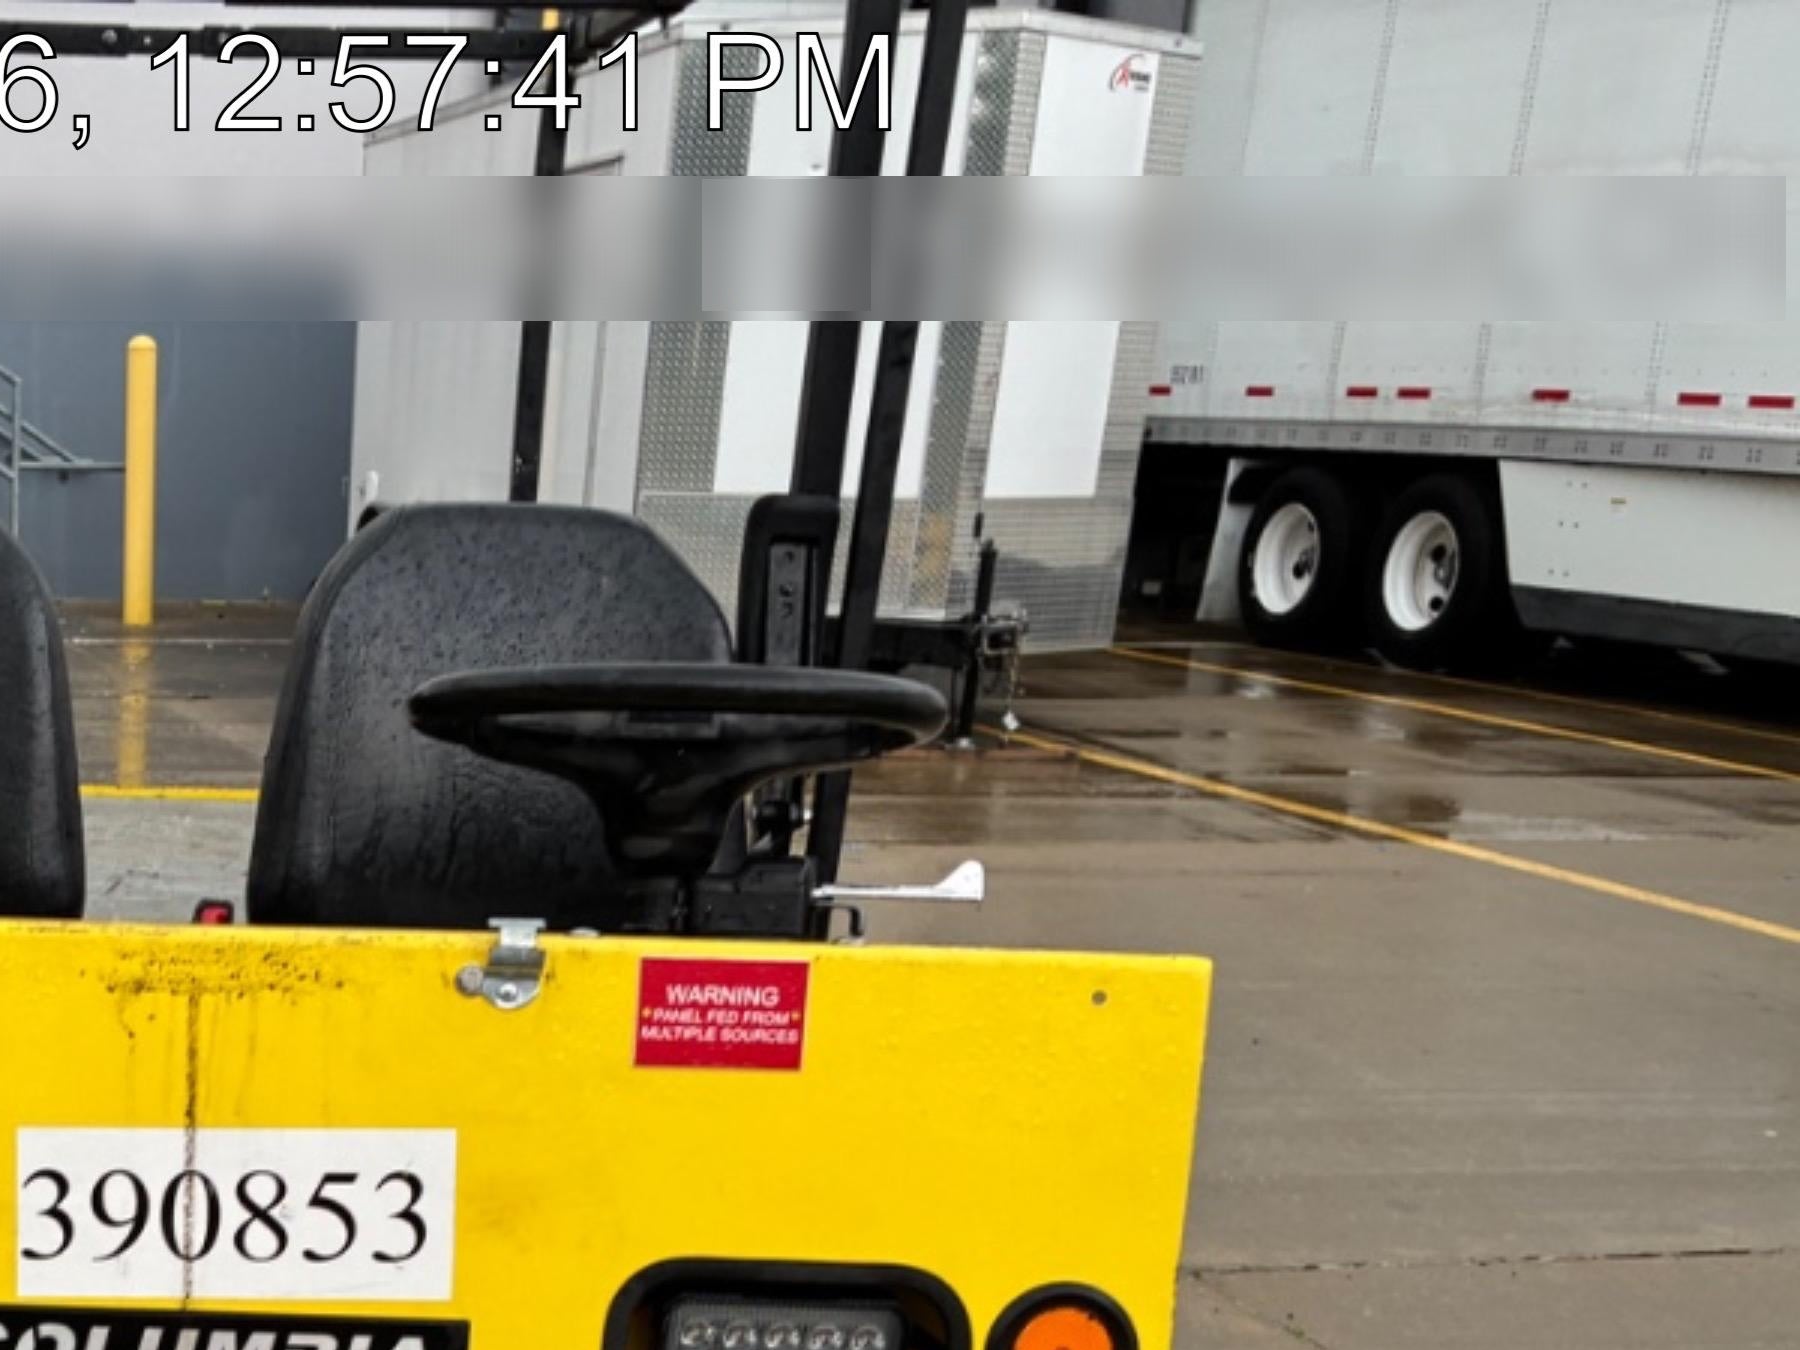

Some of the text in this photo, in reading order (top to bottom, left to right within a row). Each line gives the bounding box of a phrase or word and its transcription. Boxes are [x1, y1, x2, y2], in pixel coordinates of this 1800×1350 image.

[666, 984, 779, 1006] WARNING
[654, 1008, 790, 1027] PANEL FED FROM
[641, 1025, 798, 1044] MULTIPLE SOURCES
[20, 1168, 428, 1264] 390853
